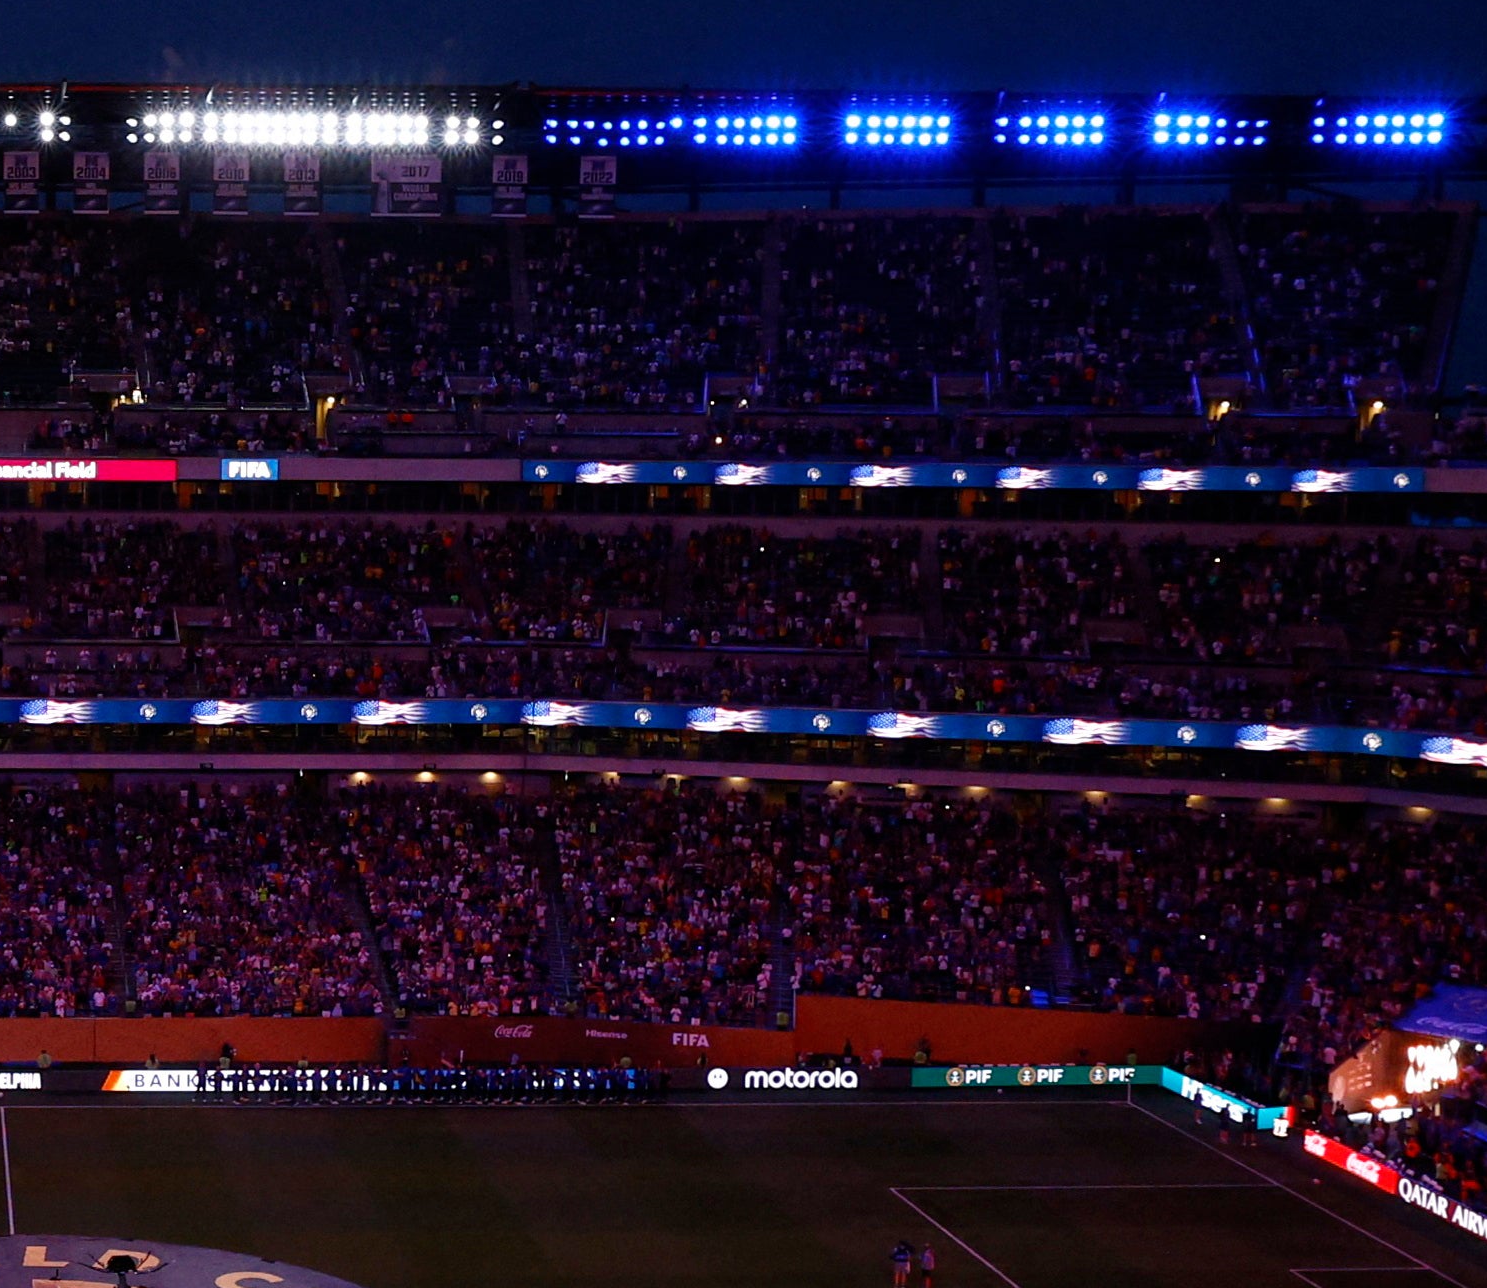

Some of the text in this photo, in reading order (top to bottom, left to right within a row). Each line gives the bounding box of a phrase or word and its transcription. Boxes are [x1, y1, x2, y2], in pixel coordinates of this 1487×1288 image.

[55, 461, 96, 478] Field
[227, 460, 270, 479] FIFA
[672, 1032, 710, 1047] FIFA
[744, 1066, 858, 1089] motorola
[965, 1069, 992, 1085] PIF
[1037, 1068, 1064, 1084] PIF
[1398, 1177, 1448, 1219] QATAR
